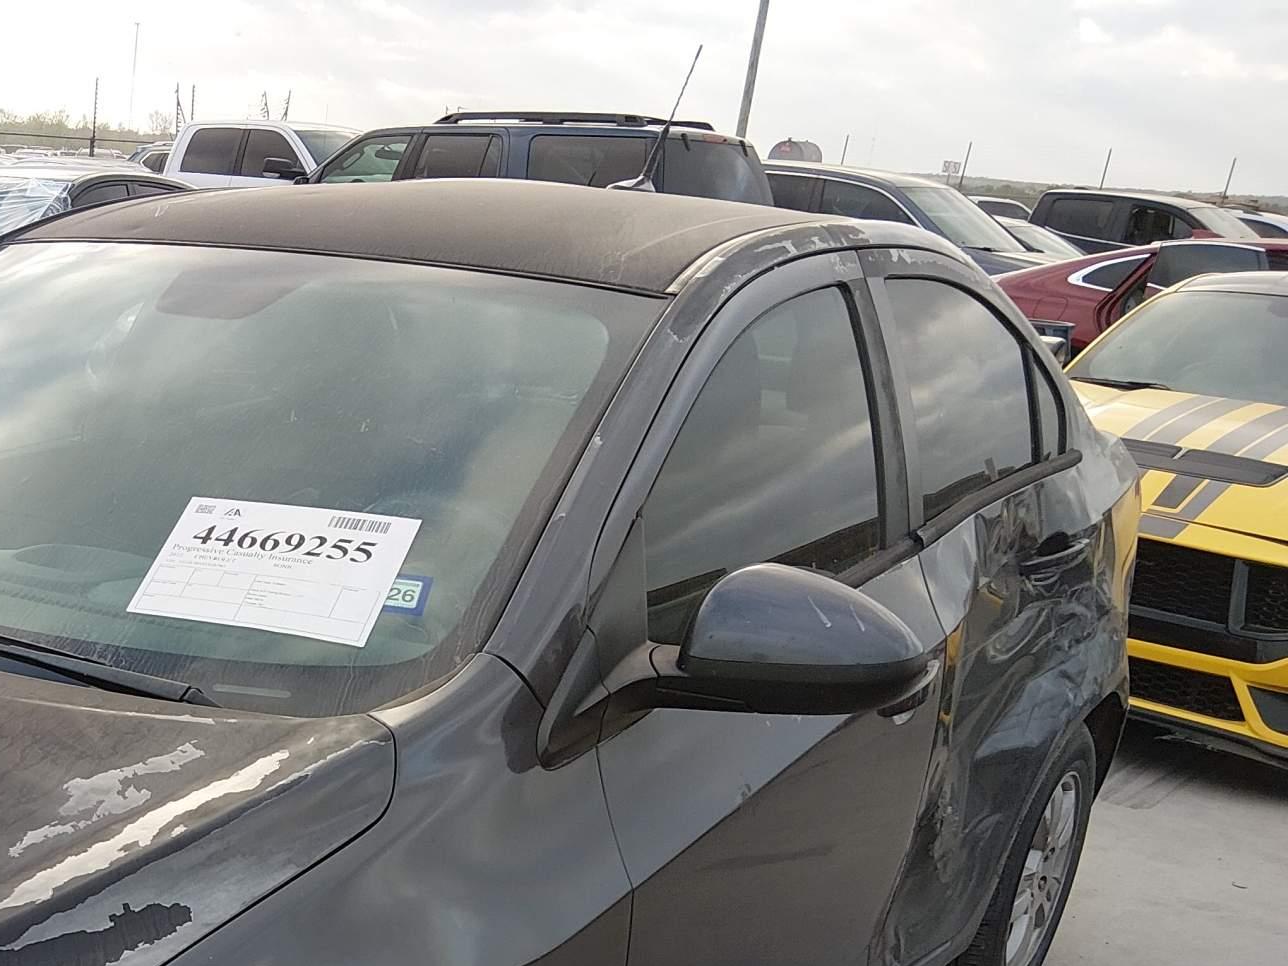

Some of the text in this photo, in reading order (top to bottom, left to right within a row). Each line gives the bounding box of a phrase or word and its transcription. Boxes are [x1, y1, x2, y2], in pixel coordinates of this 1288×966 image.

[173, 543, 313, 565] Progressive Casualty Insurance
[193, 525, 378, 563] 44669255
[386, 588, 416, 602] 26
